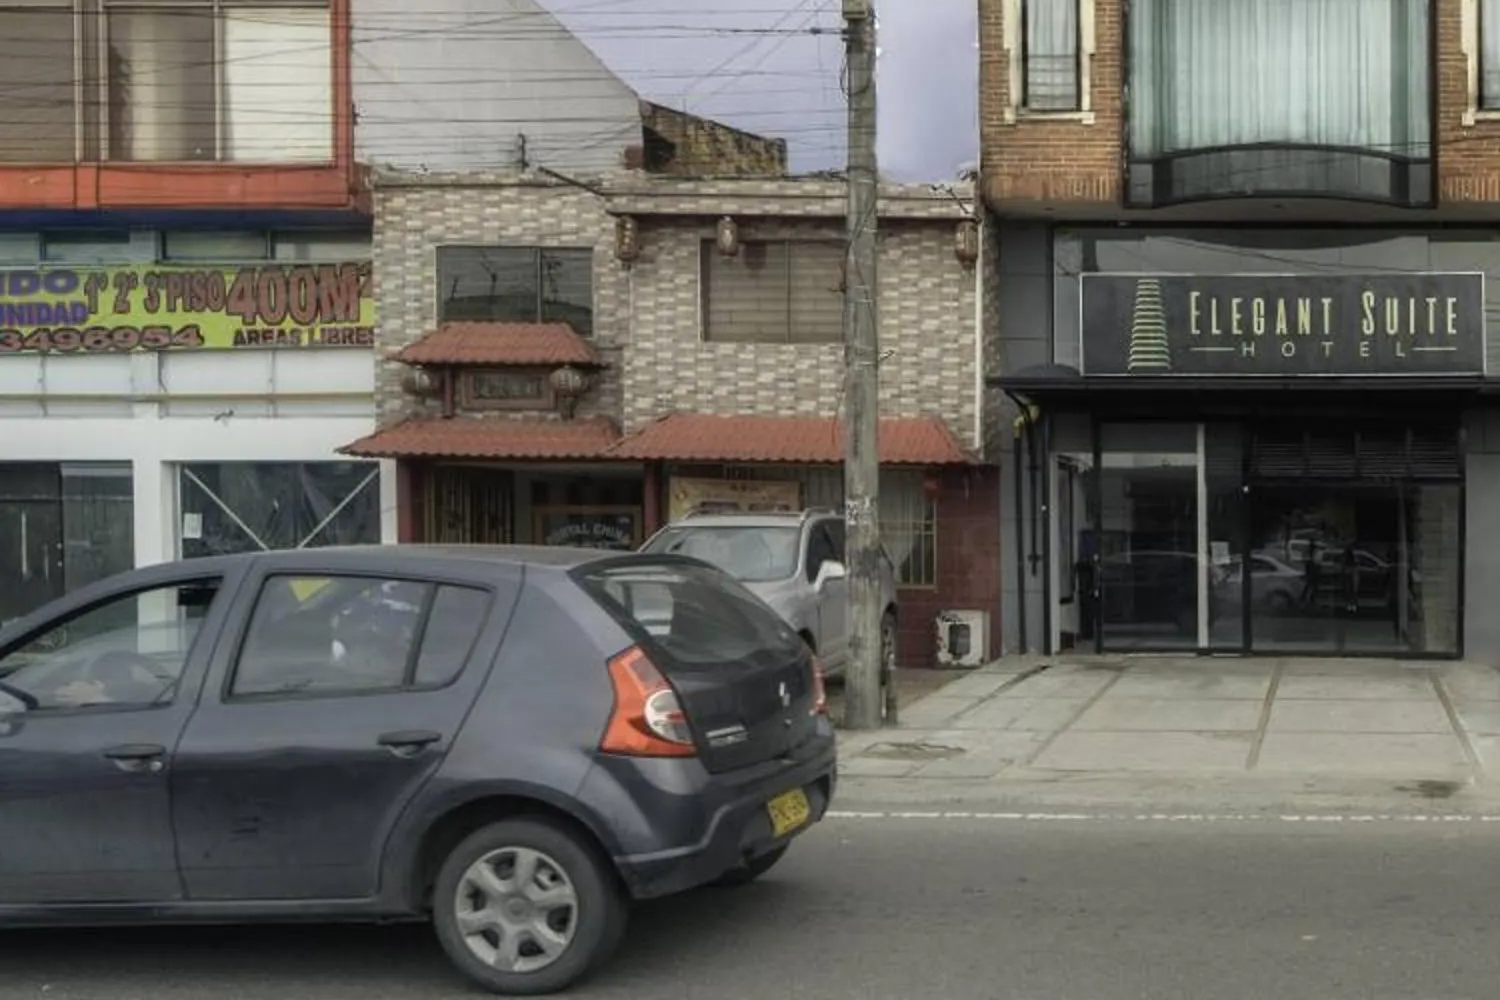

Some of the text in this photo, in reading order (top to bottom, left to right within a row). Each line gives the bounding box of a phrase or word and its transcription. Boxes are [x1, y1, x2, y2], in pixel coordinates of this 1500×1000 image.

[0, 270, 79, 296] DO
[0, 302, 90, 326] NIDAD
[1189, 289, 1459, 337] ELEGANT SUITE
[1241, 340, 1407, 359] HOTEL
